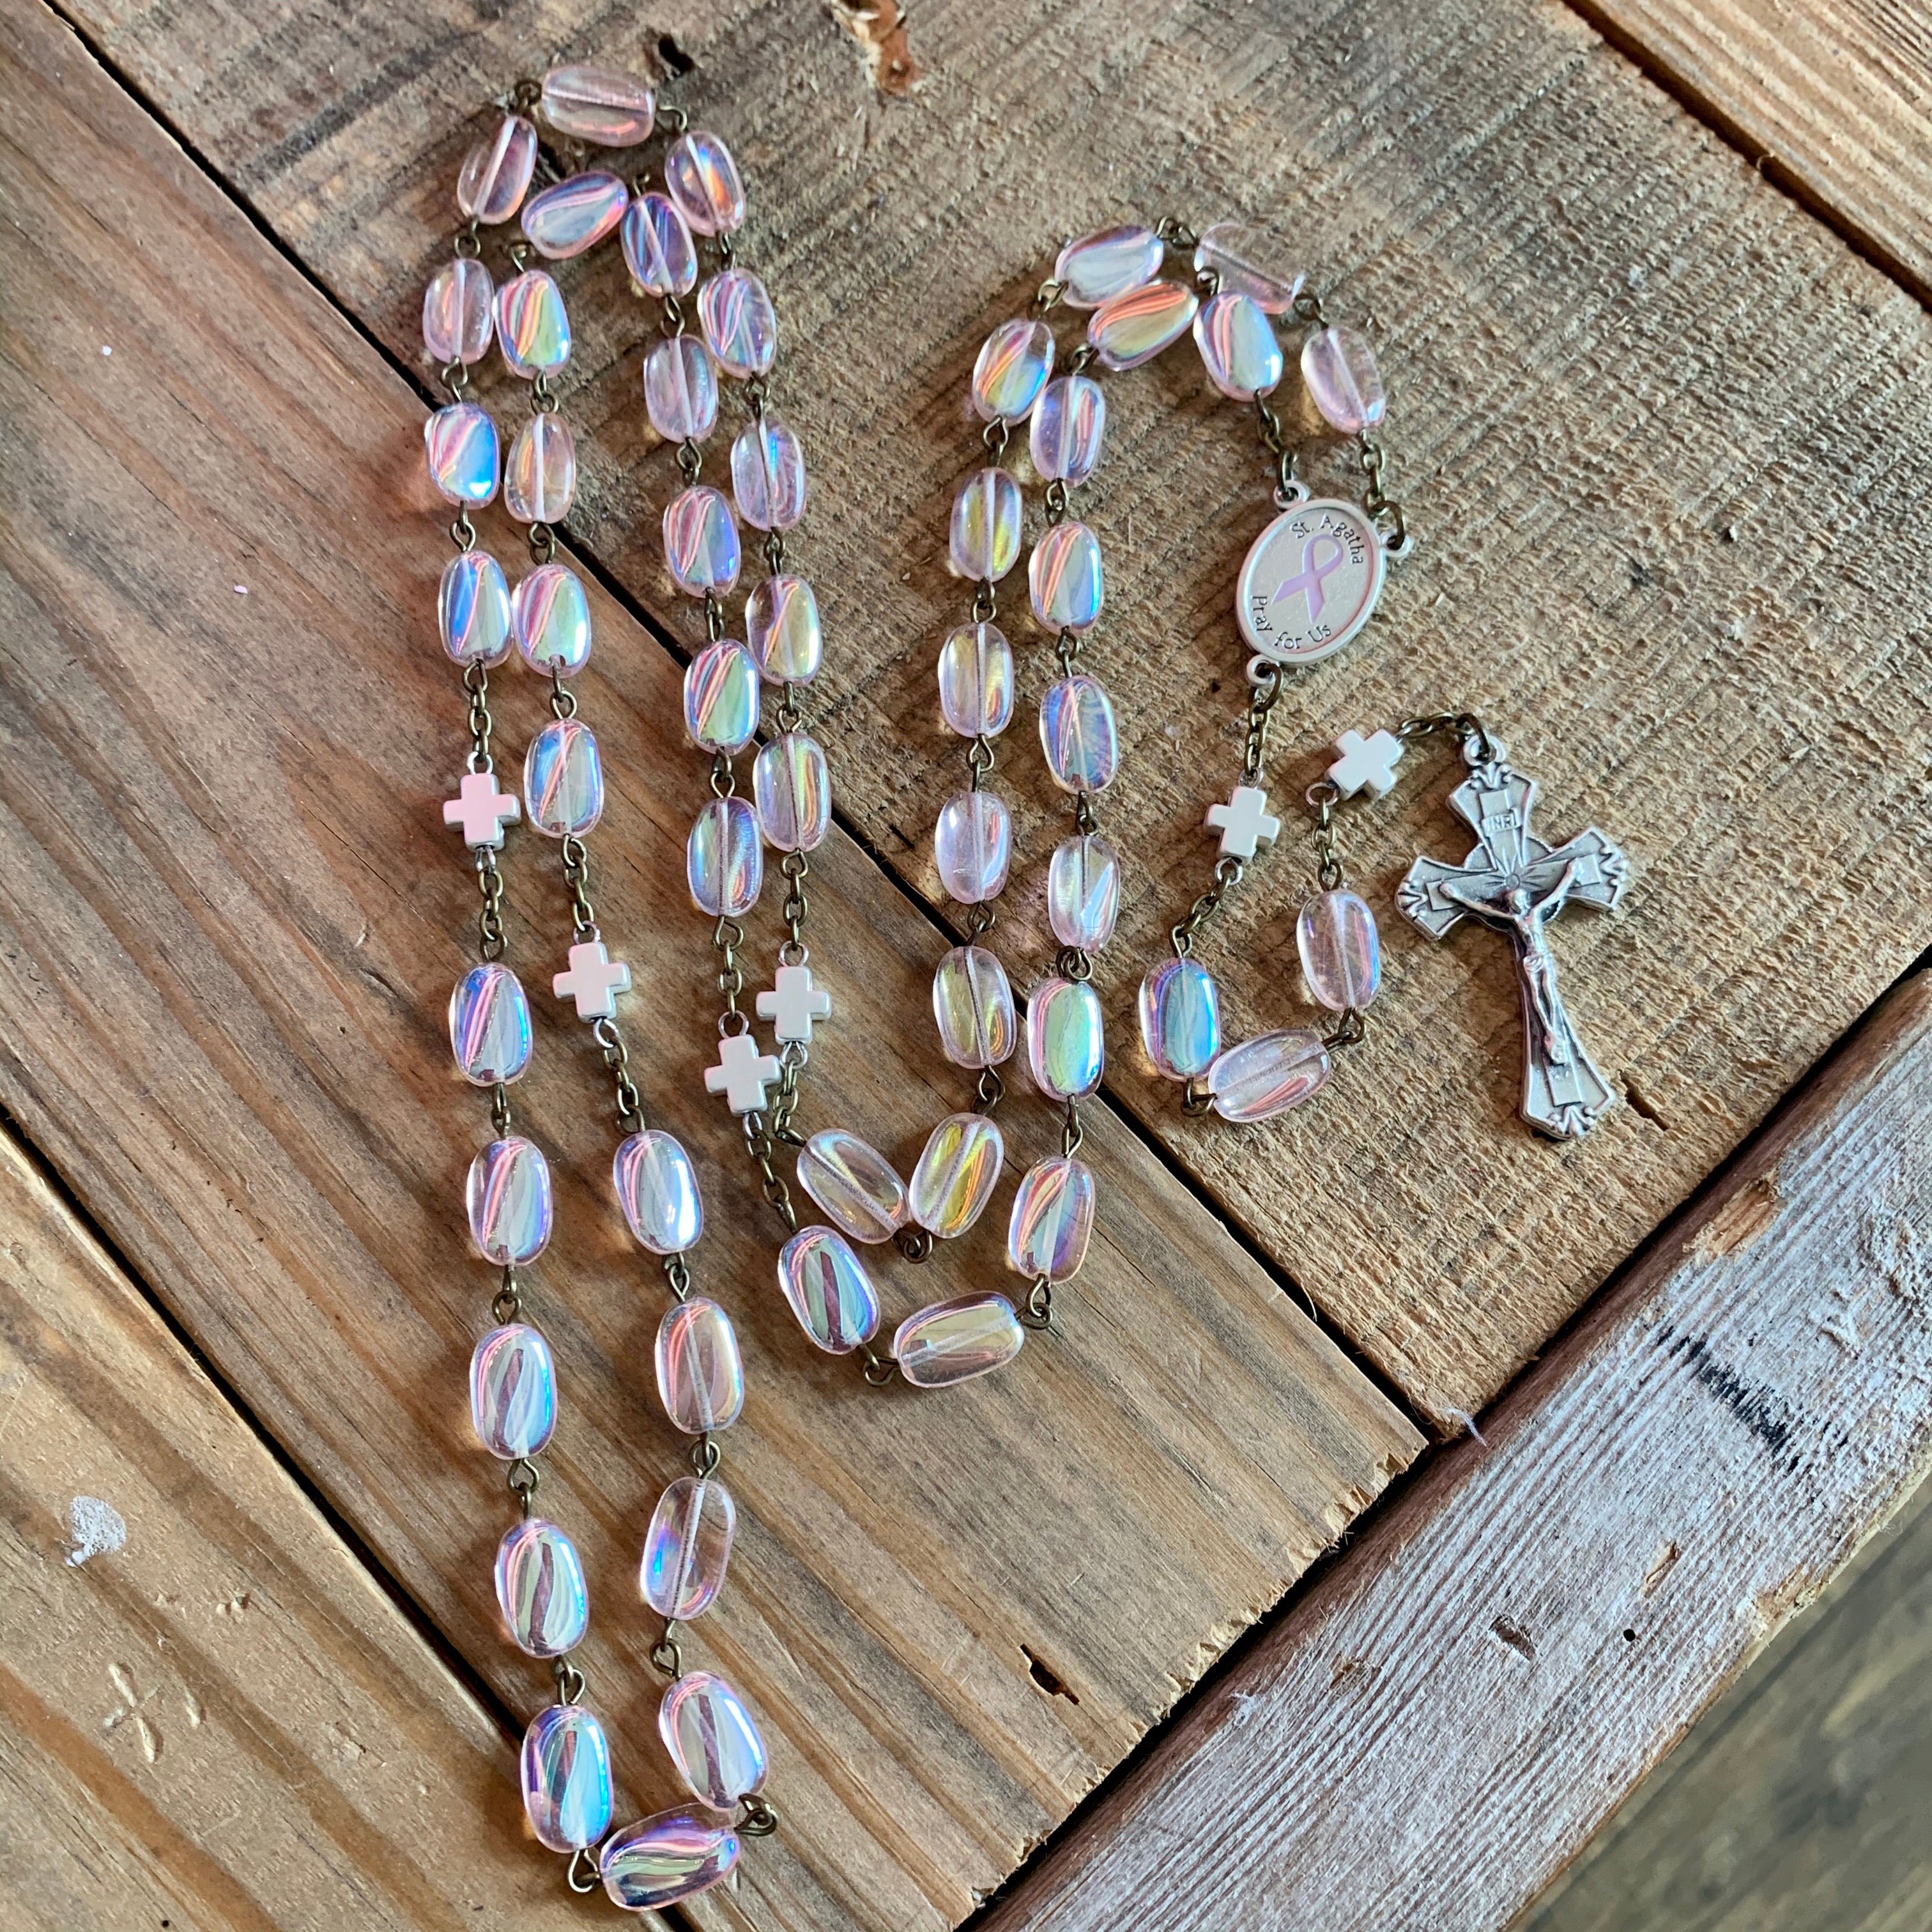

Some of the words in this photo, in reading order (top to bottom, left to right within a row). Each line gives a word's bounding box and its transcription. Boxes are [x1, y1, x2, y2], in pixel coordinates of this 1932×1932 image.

[1291, 521, 1314, 539] St.
[1319, 514, 1365, 564] Agatha
[1252, 595, 1273, 632] Pray
[1275, 632, 1302, 649] for
[1308, 624, 1331, 643] Us
